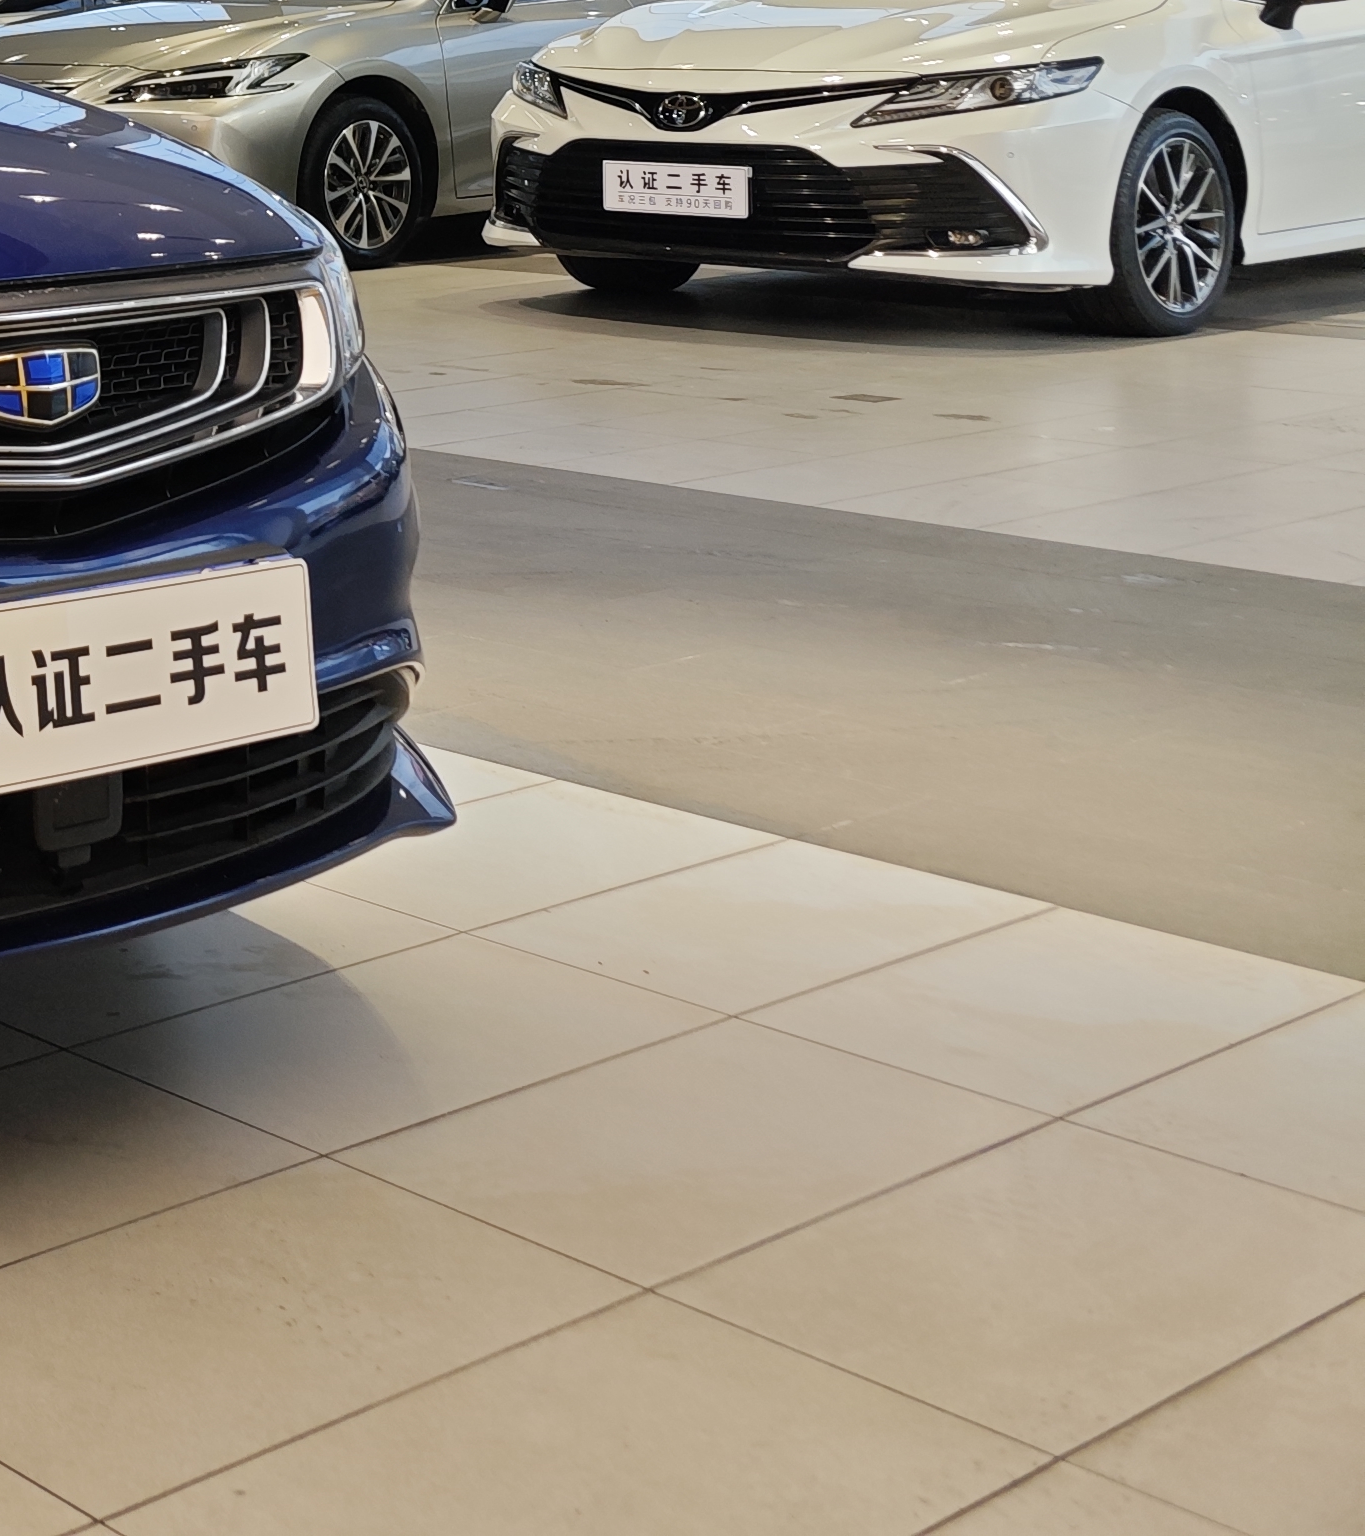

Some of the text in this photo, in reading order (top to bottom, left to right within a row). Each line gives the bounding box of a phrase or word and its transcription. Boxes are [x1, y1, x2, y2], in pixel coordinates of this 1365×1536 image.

[617, 169, 732, 195] 认证二手车
